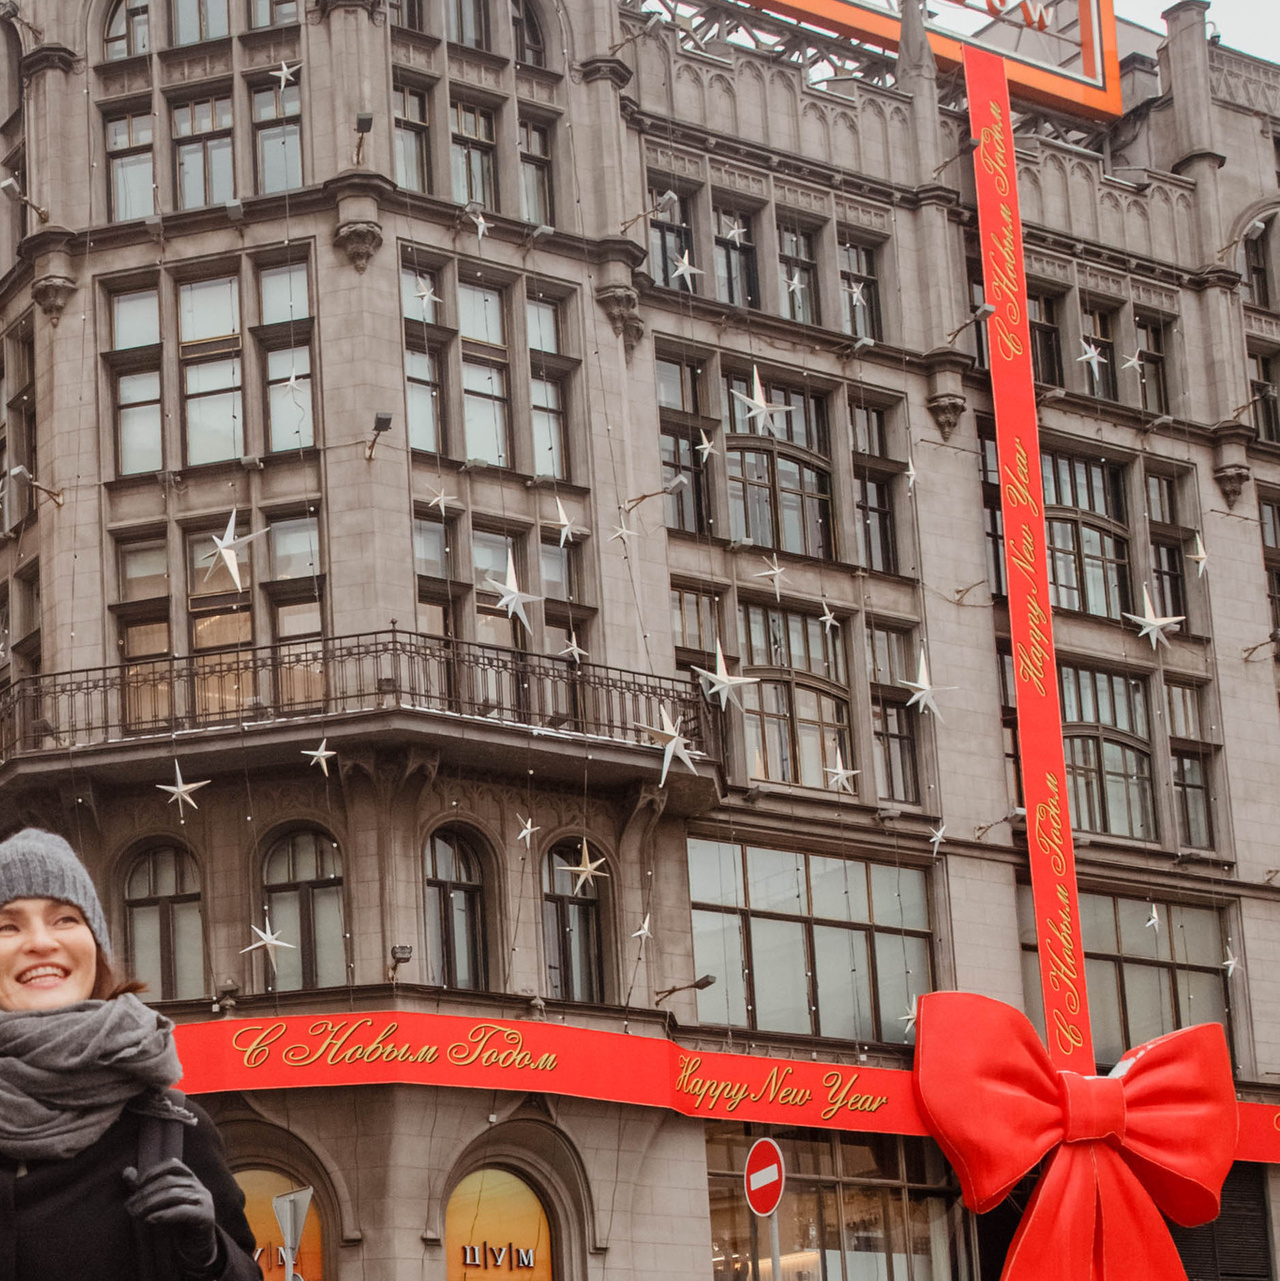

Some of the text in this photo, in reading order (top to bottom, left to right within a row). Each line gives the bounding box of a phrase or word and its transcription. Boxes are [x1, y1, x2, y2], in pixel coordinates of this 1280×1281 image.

[980, 100, 1023, 360] С Новым Годом
[1005, 436, 1051, 697] Happy New Year
[1035, 771, 1083, 1055] С Новым Годом
[233, 1018, 557, 1071] С Новым Годом
[675, 1055, 888, 1120] Happy New Year
